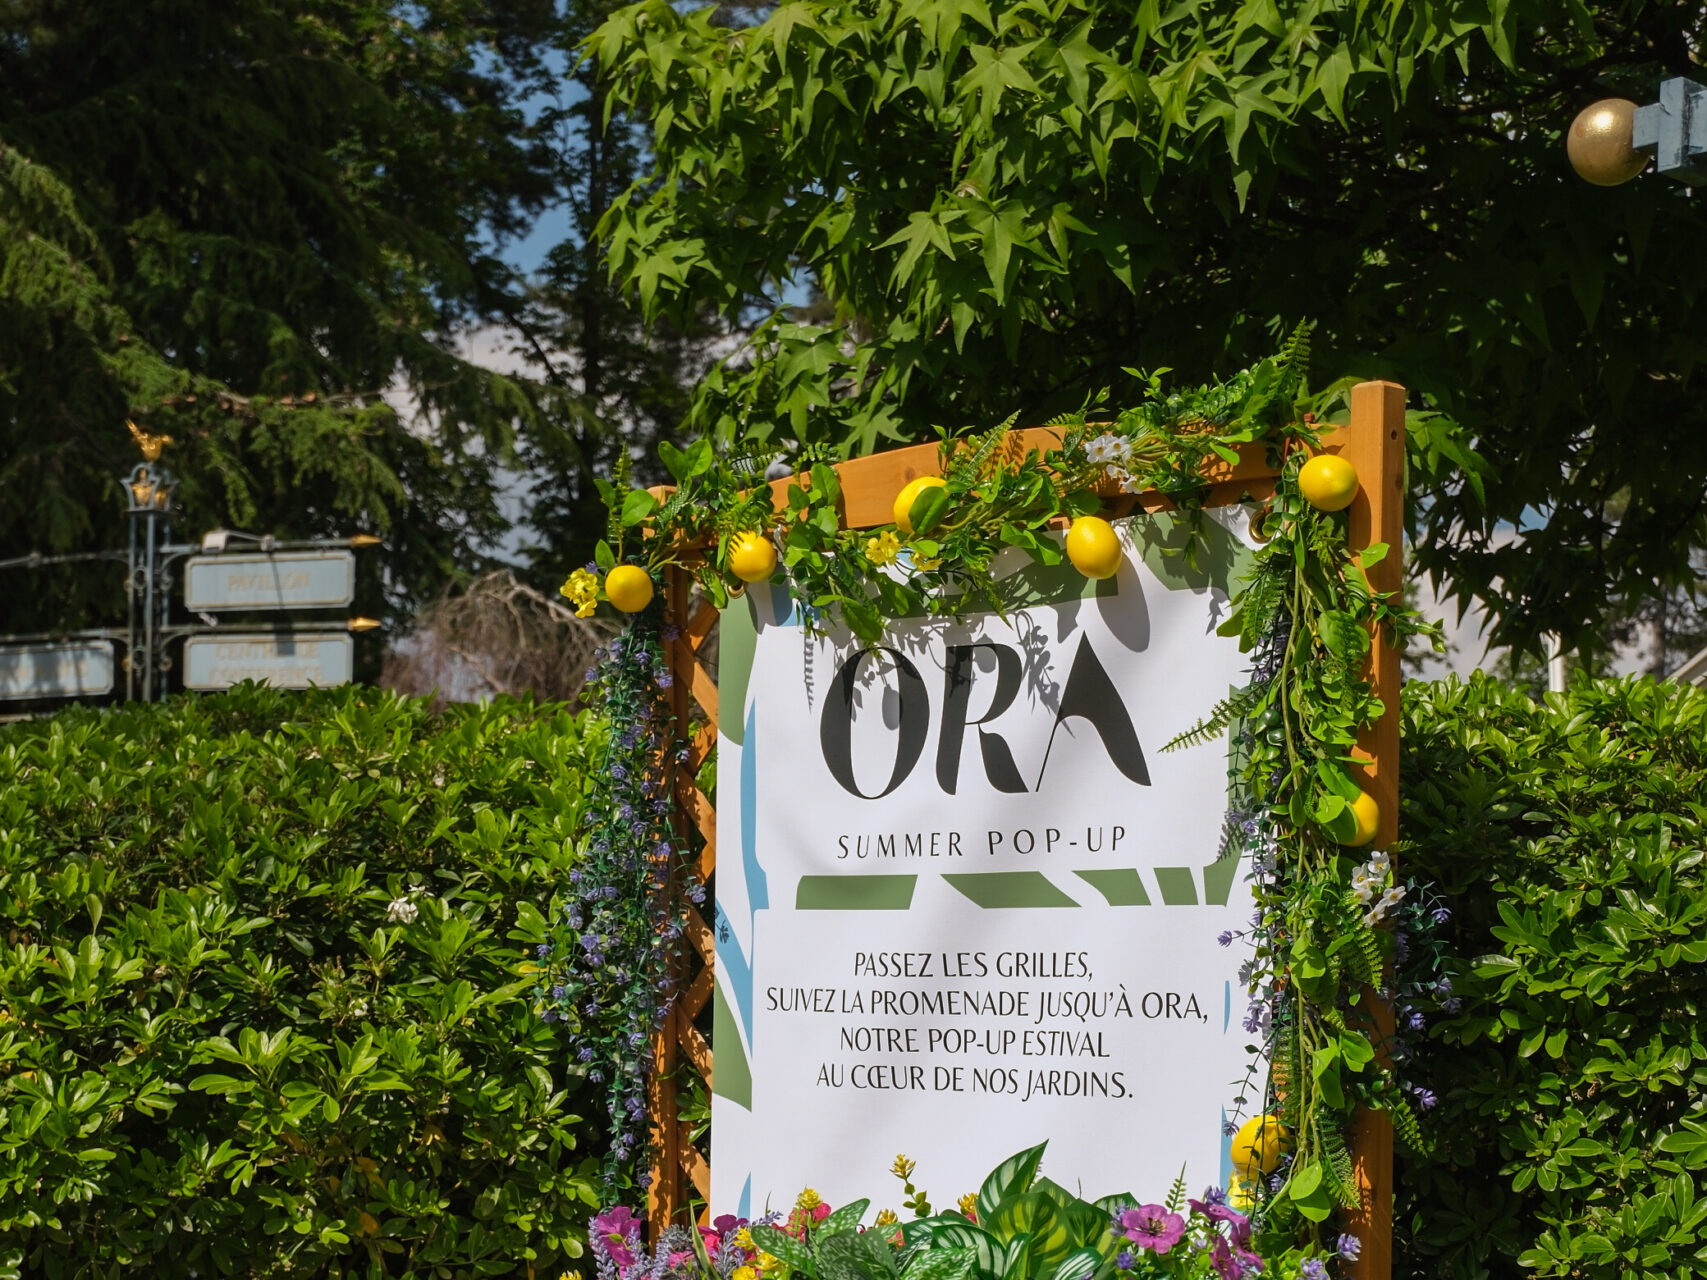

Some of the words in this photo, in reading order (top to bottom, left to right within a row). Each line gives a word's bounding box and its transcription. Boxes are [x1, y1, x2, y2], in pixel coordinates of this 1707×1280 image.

[227, 571, 310, 592] PAVILLON
[819, 630, 1152, 800] ORA
[837, 831, 963, 859] SUMMER
[987, 826, 1126, 856] POP-UP
[854, 952, 934, 978] PASSEZ
[942, 952, 988, 978] LES
[996, 951, 1093, 980] GRILLES,
[767, 986, 836, 1013] SUIVEZ
[841, 989, 864, 1014] LA
[870, 990, 1029, 1017] PROMENADE
[1034, 983, 1133, 1025] JUSQU'À
[1141, 991, 1209, 1024] ORA,
[841, 1027, 920, 1053] NOTRE
[928, 1028, 1016, 1055] POP-UP
[1022, 1030, 1110, 1058] ESTIVAL
[817, 1063, 844, 1088] AU
[851, 1064, 926, 1091] CŒUR
[934, 1066, 965, 1092] DE
[973, 1068, 1018, 1094] NOS
[1021, 1069, 1133, 1102] JARDINS.
